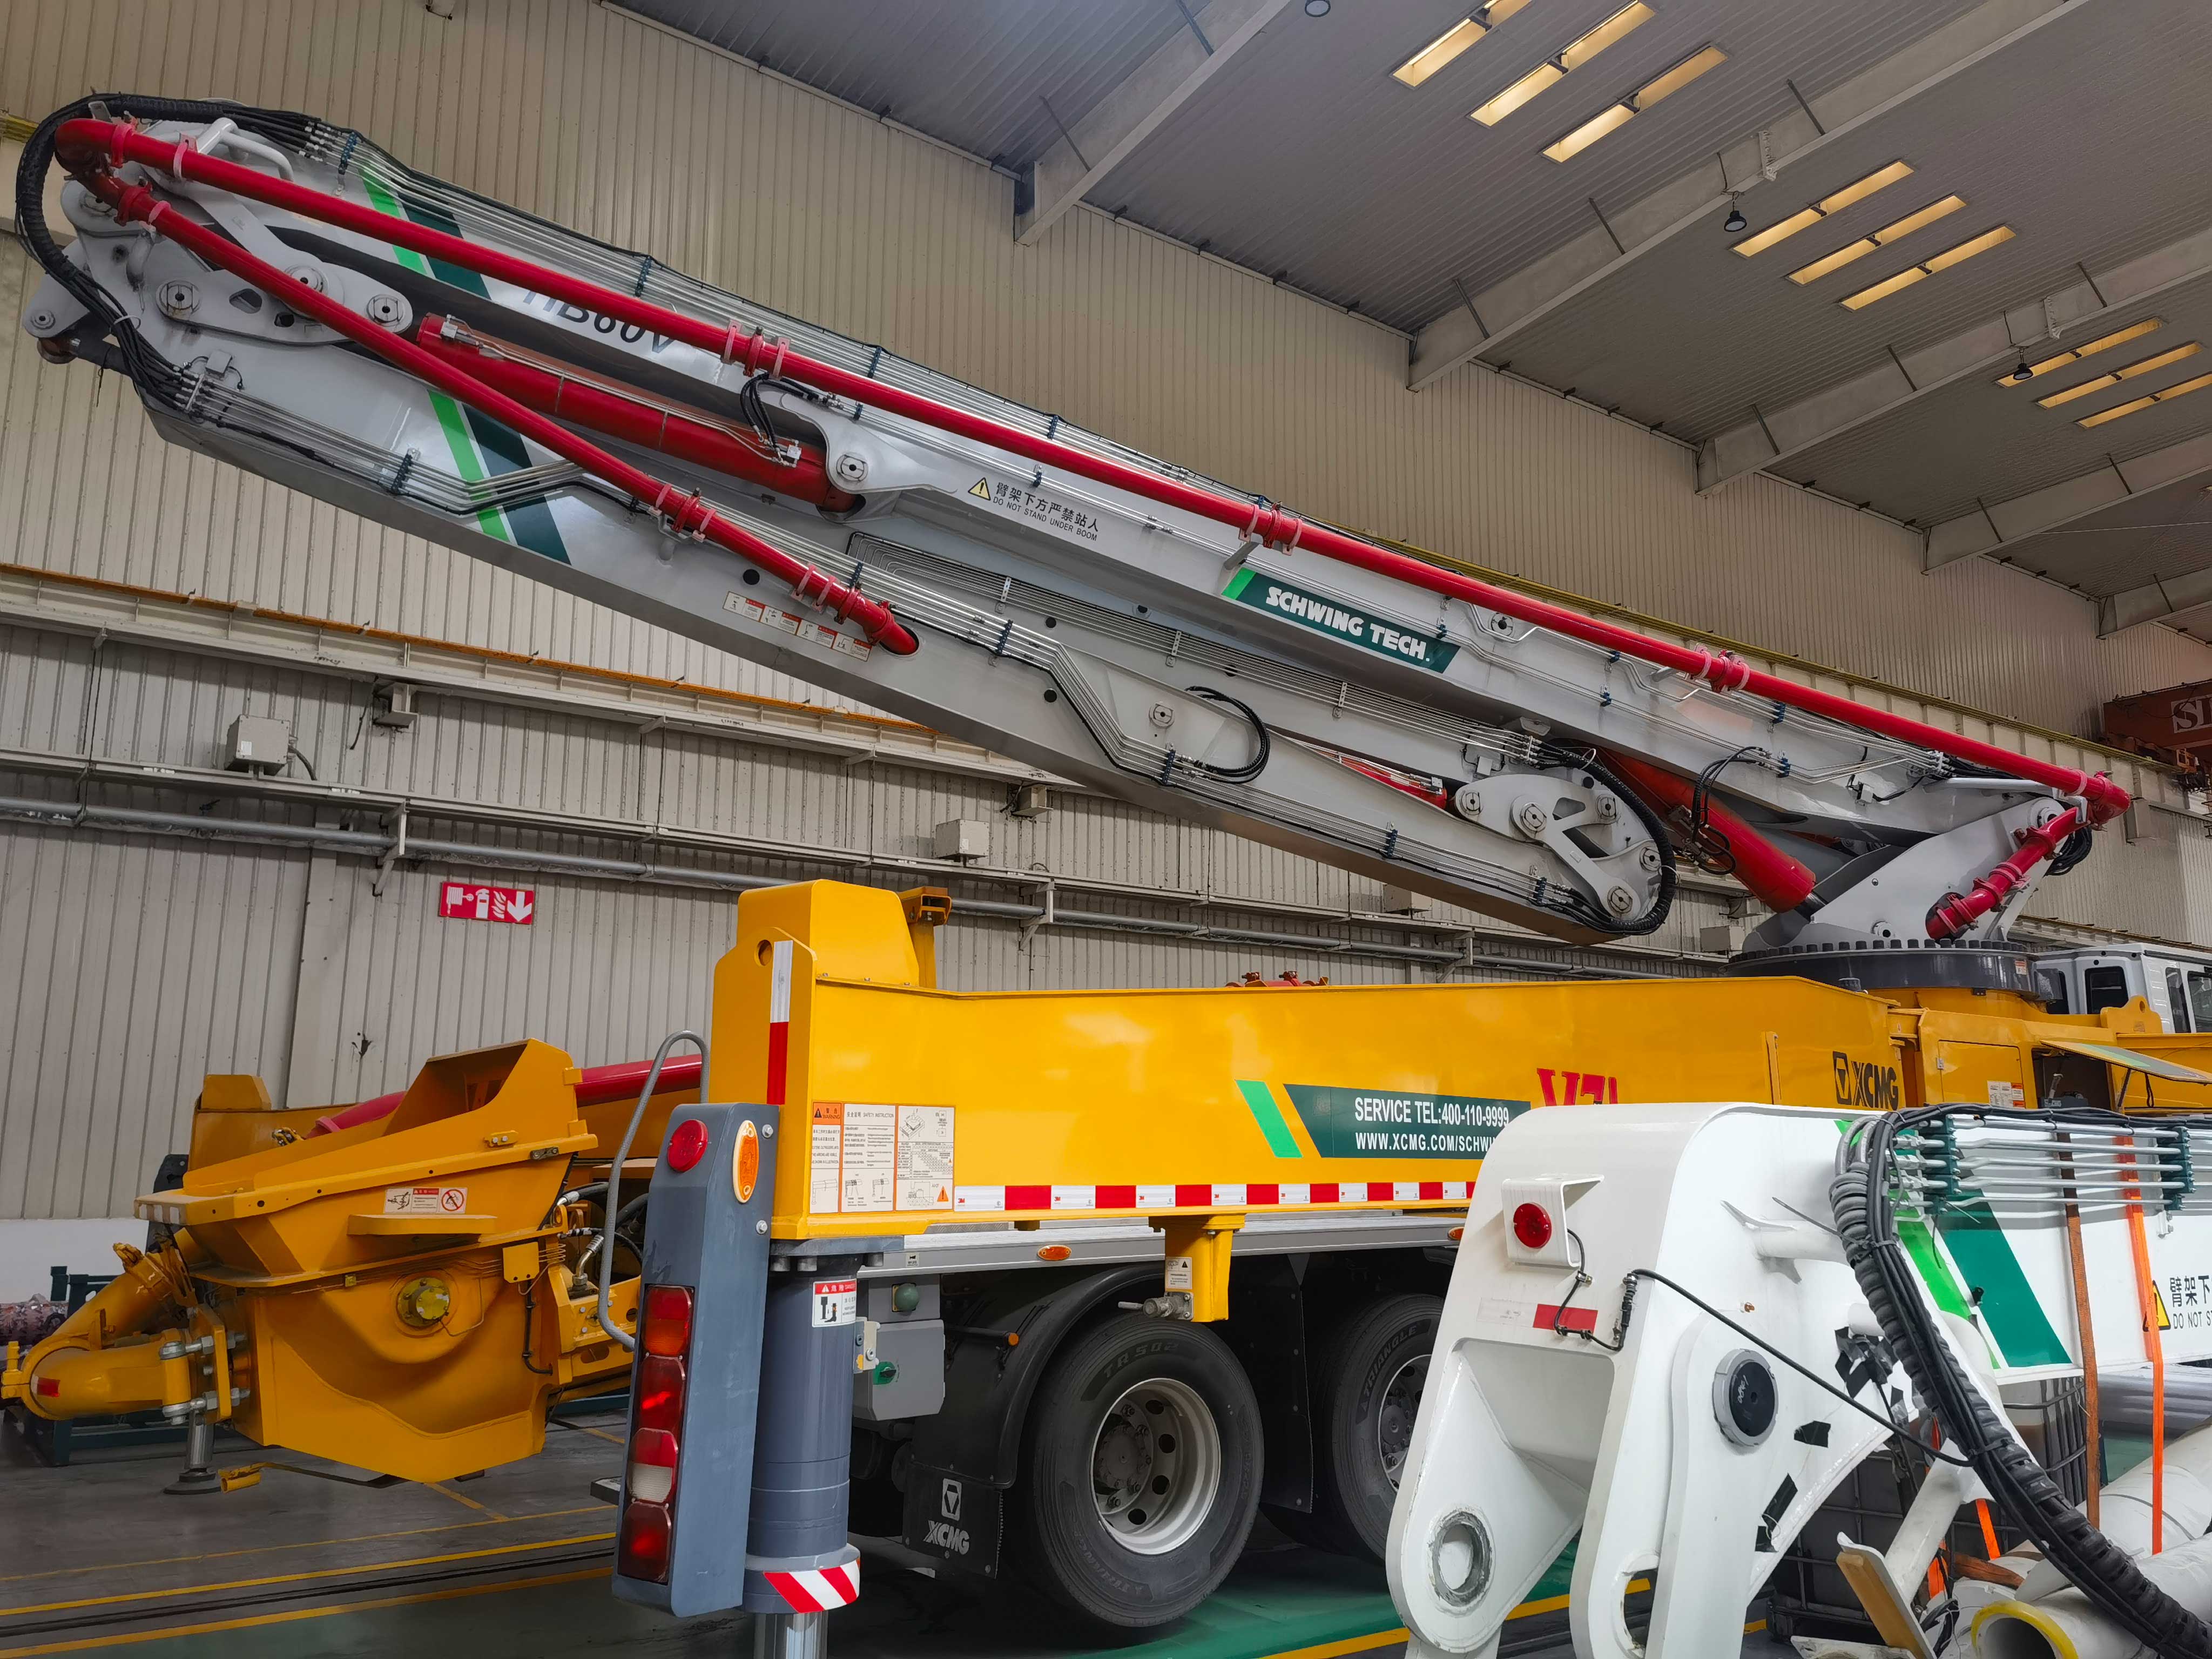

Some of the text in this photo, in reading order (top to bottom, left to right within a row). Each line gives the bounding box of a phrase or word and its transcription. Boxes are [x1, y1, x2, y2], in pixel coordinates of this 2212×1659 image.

[993, 496, 1097, 541] DO NOT STAND UNDER BOOM
[997, 482, 1098, 532] 臂架下方严禁站人
[1266, 586, 1430, 662] SCHWING TECH.
[1851, 1061, 1899, 1111] XCMG
[1355, 1097, 1509, 1128] SERVICE TEL:400-110-9999
[2169, 1275, 2212, 1307] 臂架下
[2173, 1313, 2184, 1329] DO
[2188, 1311, 2202, 1328] NOT
[1363, 1325, 1418, 1397] TRIANGLE
[923, 1520, 970, 1555] XCMG
